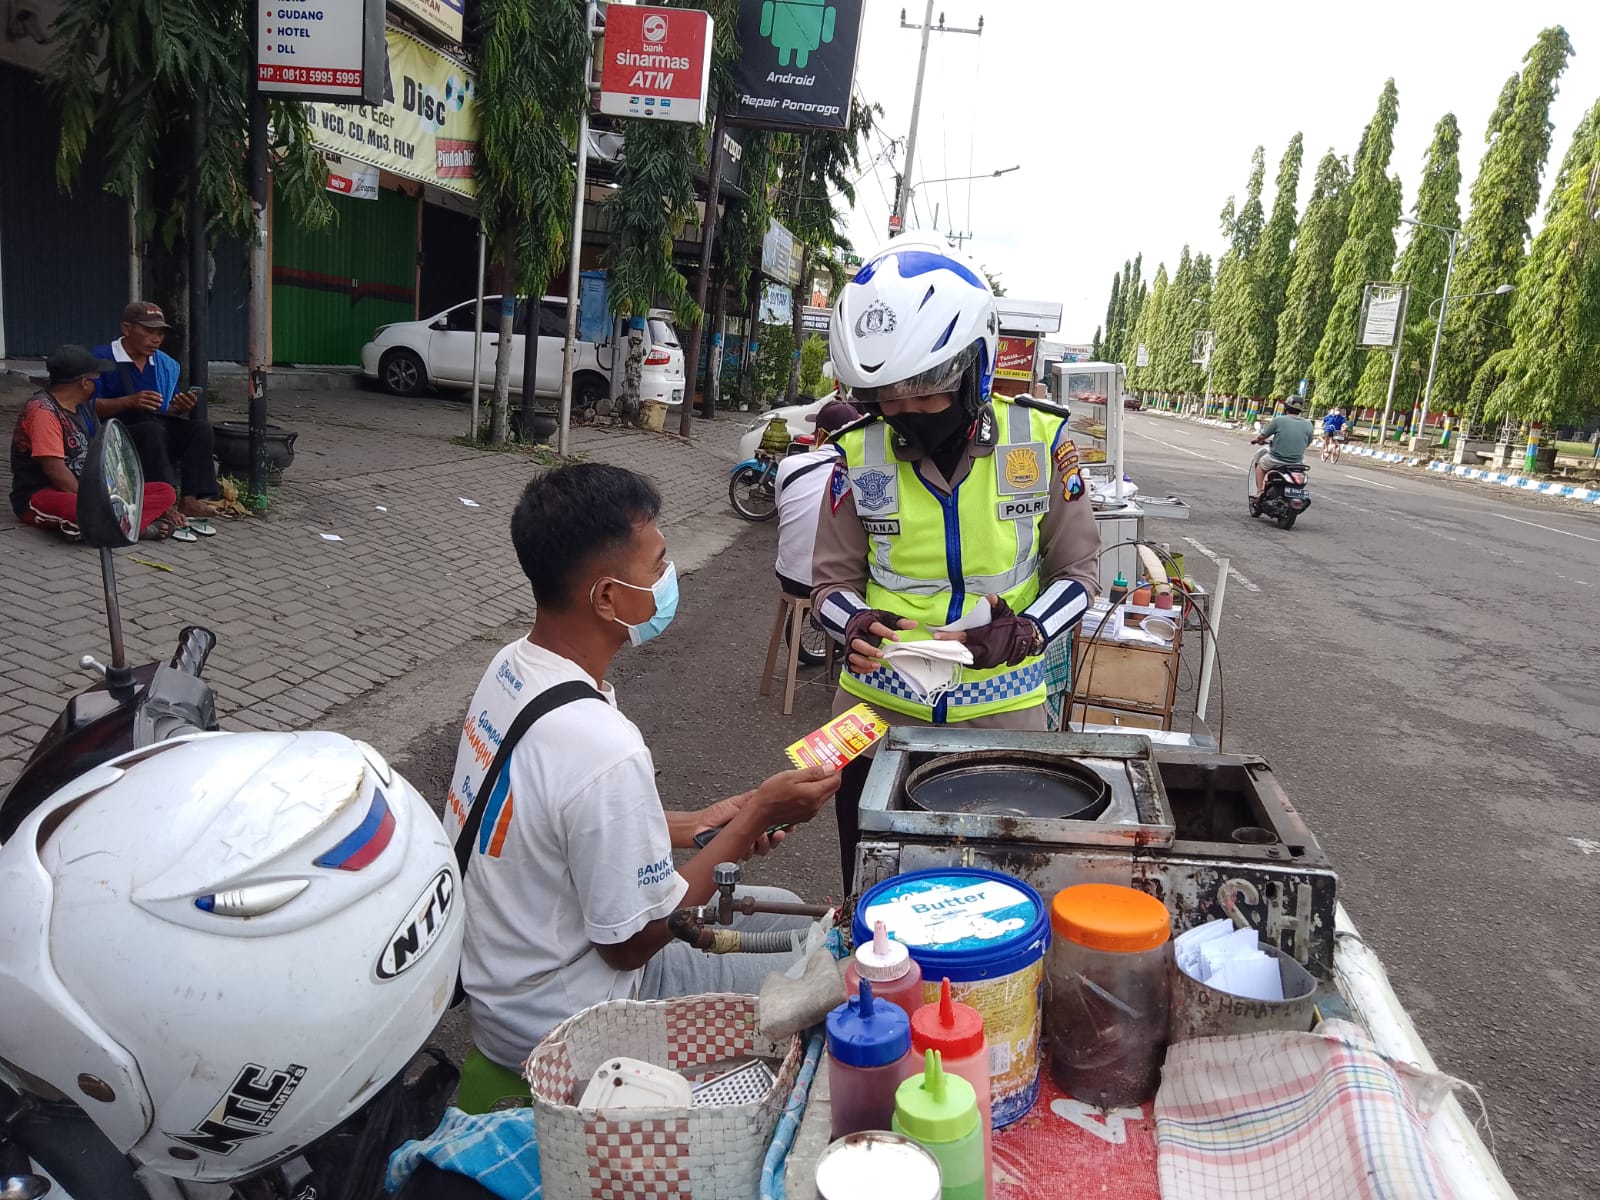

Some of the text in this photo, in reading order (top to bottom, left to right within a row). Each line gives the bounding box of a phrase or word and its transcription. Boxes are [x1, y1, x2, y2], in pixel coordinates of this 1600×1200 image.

[277, 9, 324, 20] GUDANG
[277, 27, 310, 38] HOTEL
[277, 44, 296, 54] DLL
[643, 44, 664, 53] bank
[616, 49, 690, 71] sinarmas
[259, 67, 273, 79] HP
[282, 68, 307, 81] 0813
[309, 70, 334, 83] 5995
[335, 72, 361, 85] 5995
[629, 71, 674, 90] ATM
[766, 71, 815, 87] Android
[741, 95, 840, 116] Repair Ponorogo
[371, 105, 396, 129] Ecer
[321, 109, 346, 138] VCD,
[348, 121, 366, 145] CD,
[393, 137, 416, 161] FILM
[438, 149, 463, 168] Pindah
[1006, 501, 1044, 516] POLRI
[637, 855, 669, 878] BANK
[911, 891, 987, 914] Butter
[393, 873, 452, 972] NTC
[258, 1067, 306, 1127] HELMETS
[164, 1063, 291, 1155] NTC
